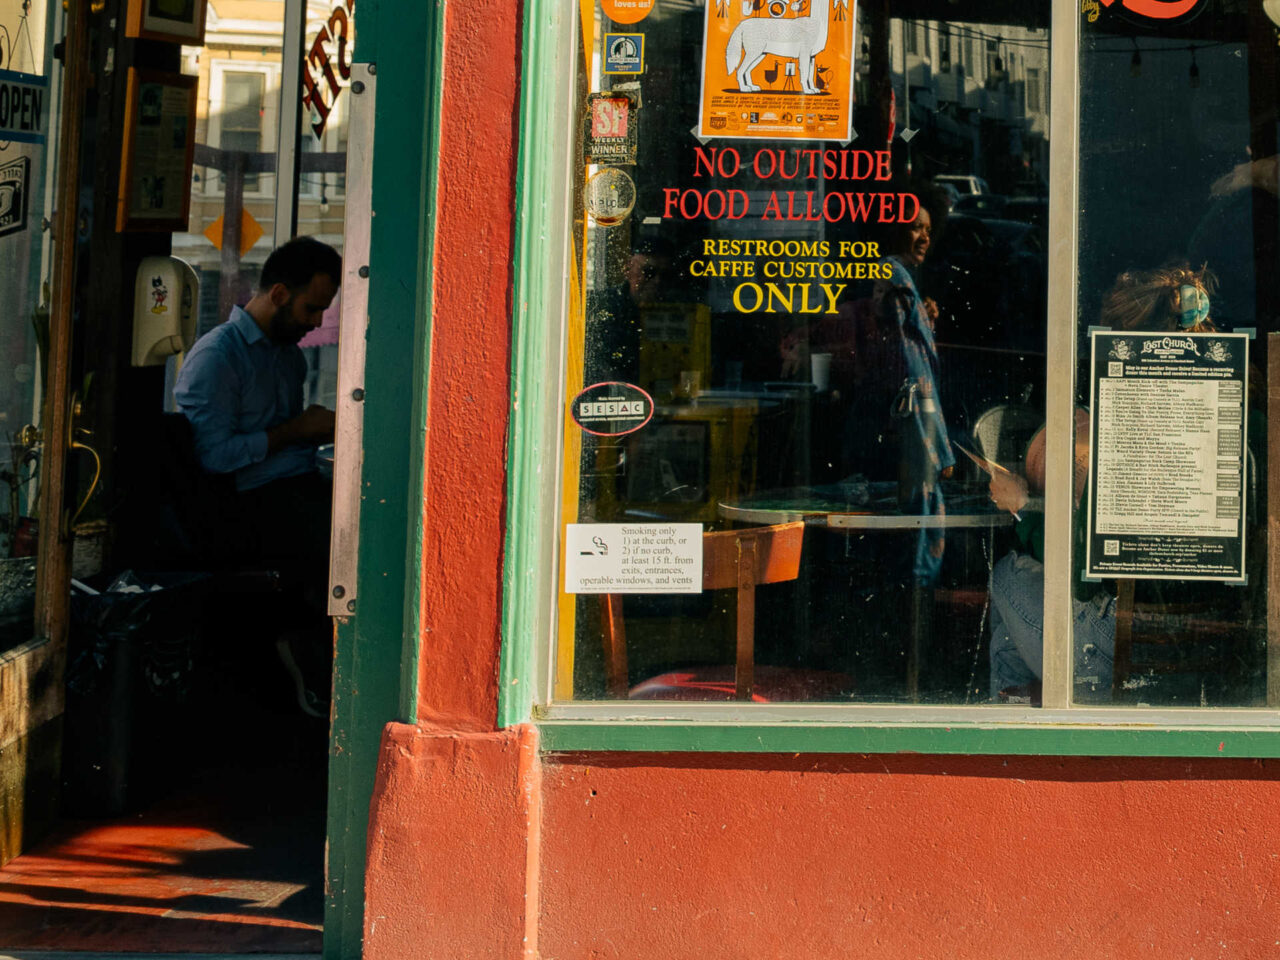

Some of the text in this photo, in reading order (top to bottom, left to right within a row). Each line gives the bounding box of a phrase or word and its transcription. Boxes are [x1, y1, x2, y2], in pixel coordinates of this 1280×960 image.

[614, 0, 651, 9] loves us!
[591, 144, 628, 155] WINNER
[692, 146, 893, 182] NO OUTSIDE
[662, 187, 921, 224] FOOD ALLOWED
[702, 238, 882, 259] RESTROOMS FOR
[689, 259, 893, 280] CAFFE CUSTOMERS
[732, 281, 848, 315] ONLY
[583, 403, 641, 414] SESAC
[621, 526, 677, 537] Smoking only
[622, 537, 631, 545] 1)
[632, 537, 640, 545] at
[641, 537, 655, 545] the
[656, 537, 677, 546] curb,
[622, 546, 631, 555] 2)
[632, 546, 640, 554] if
[652, 546, 673, 556] curb,
[621, 556, 694, 565] at least 15 ft. from
[621, 566, 684, 575] exits, entrances,
[579, 575, 693, 586] operable windows, and vents
